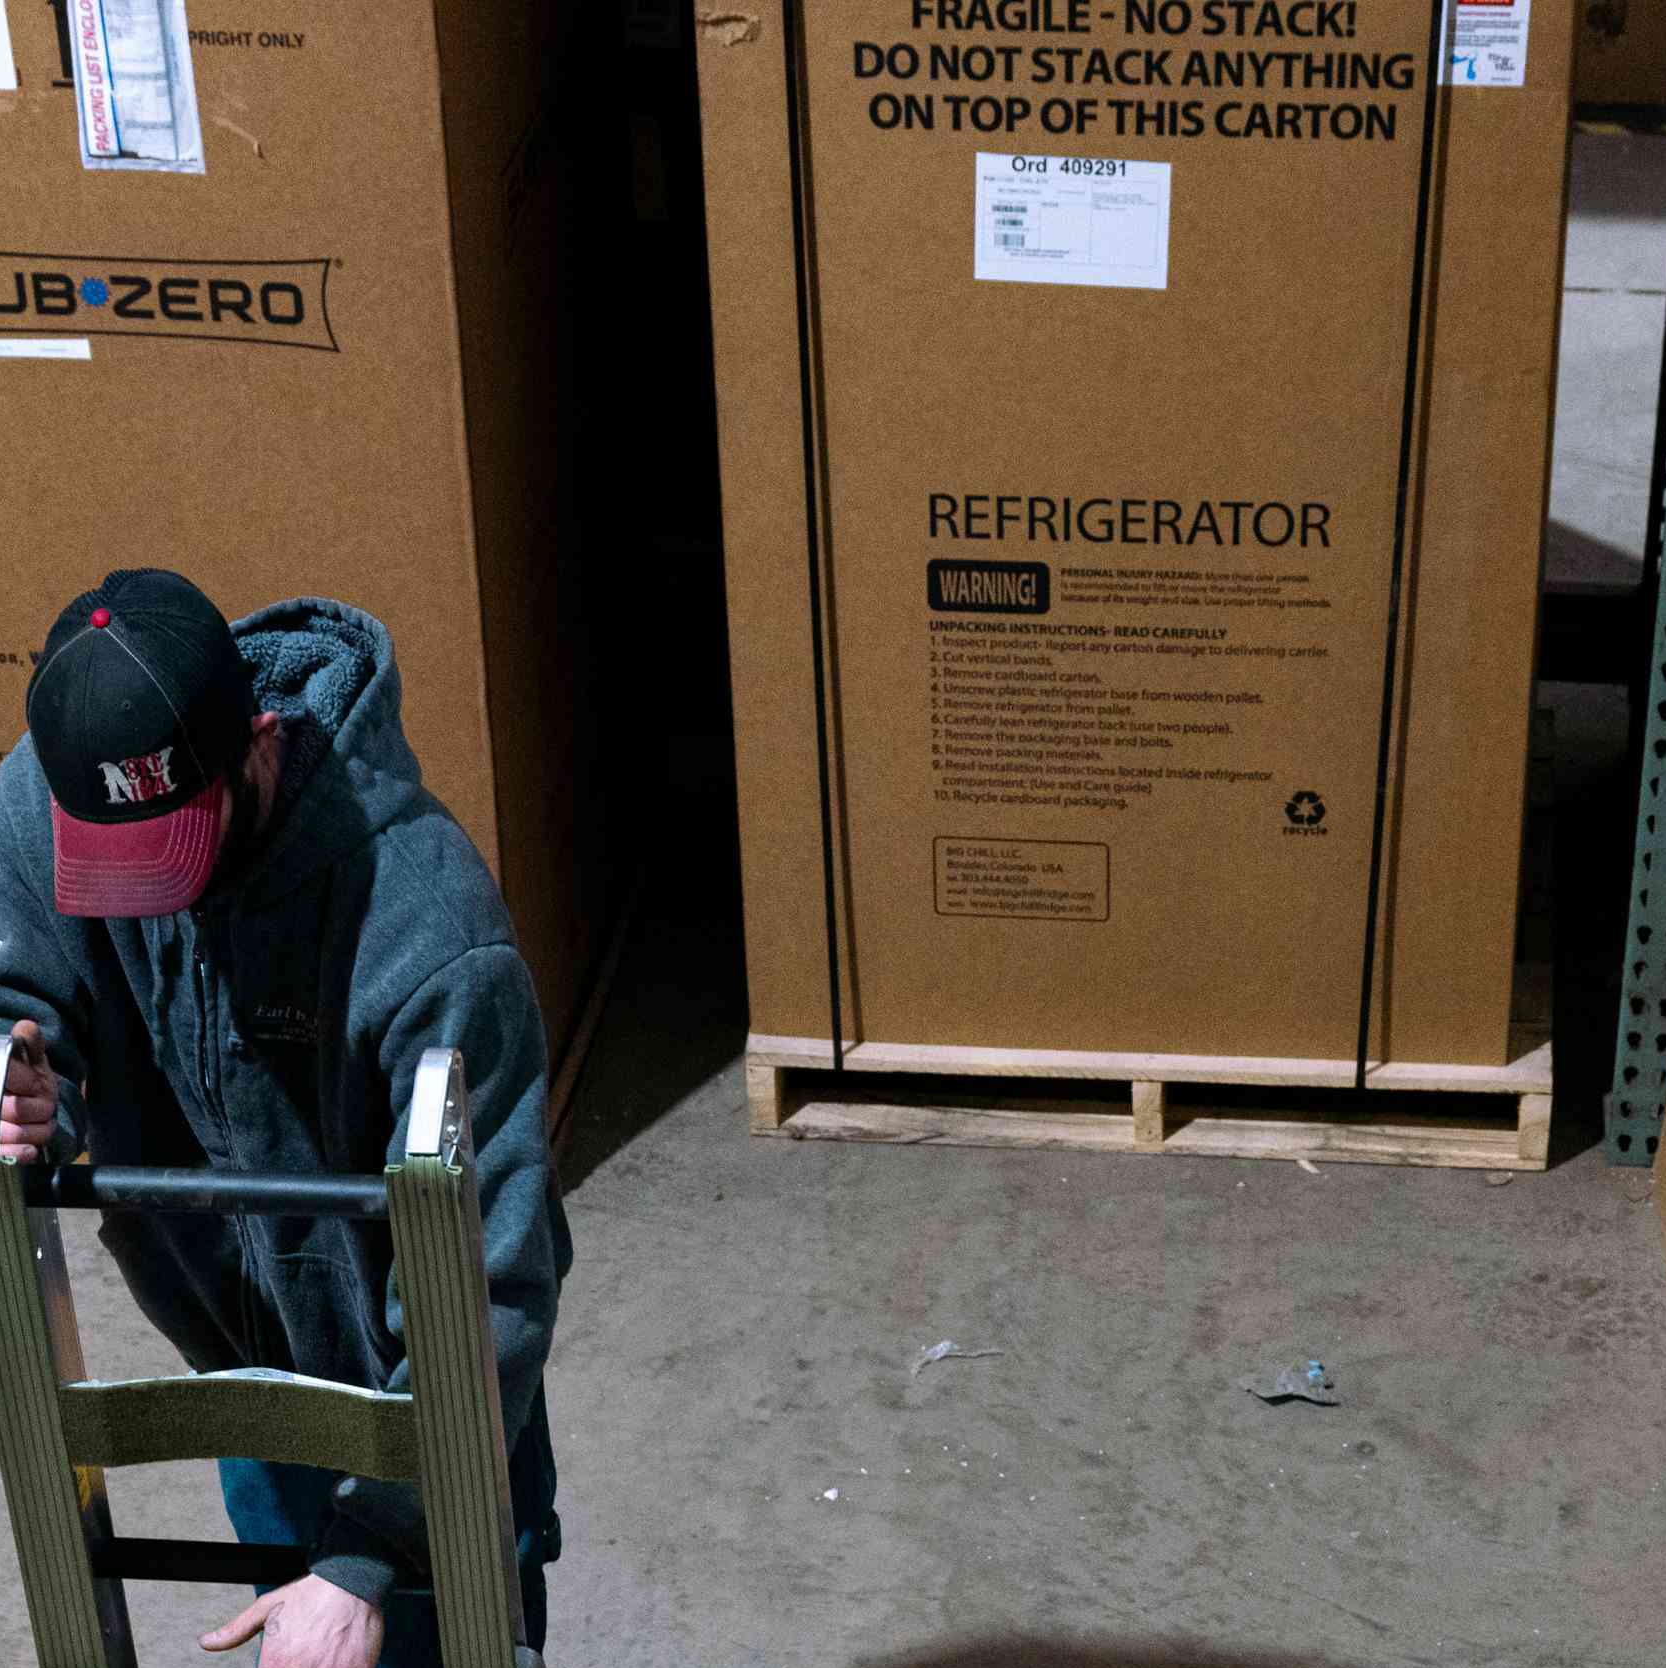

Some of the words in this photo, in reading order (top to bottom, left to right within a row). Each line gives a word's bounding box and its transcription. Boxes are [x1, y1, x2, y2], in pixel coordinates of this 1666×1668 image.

[911, 0, 1091, 33] FRAGILE
[1123, 0, 1193, 36] NO
[1202, 0, 1357, 40] STACK!
[188, 31, 253, 48] PRIGHT
[257, 32, 306, 49] ONLY
[88, 54, 107, 90] LIST
[852, 41, 920, 80] DO
[928, 43, 1022, 83] NOT
[1031, 46, 1173, 88] STACK
[1181, 50, 1417, 91] ANYTHING
[89, 90, 113, 154] PACKING
[868, 93, 935, 131] ON
[942, 94, 1032, 134] TOP
[1039, 97, 1099, 135] OF
[1107, 100, 1207, 138] THIS
[1214, 102, 1397, 142] CARTON
[1011, 156, 1048, 174] Ord
[1059, 158, 1127, 178] 409291
[927, 492, 1332, 549] REFRIGERATOR
[938, 569, 1037, 607] WARNING!
[929, 620, 1009, 634] UNPACKING
[1113, 626, 1150, 638] READ
[1151, 627, 1228, 641] CAREFULLY
[1282, 825, 1329, 838] recycle
